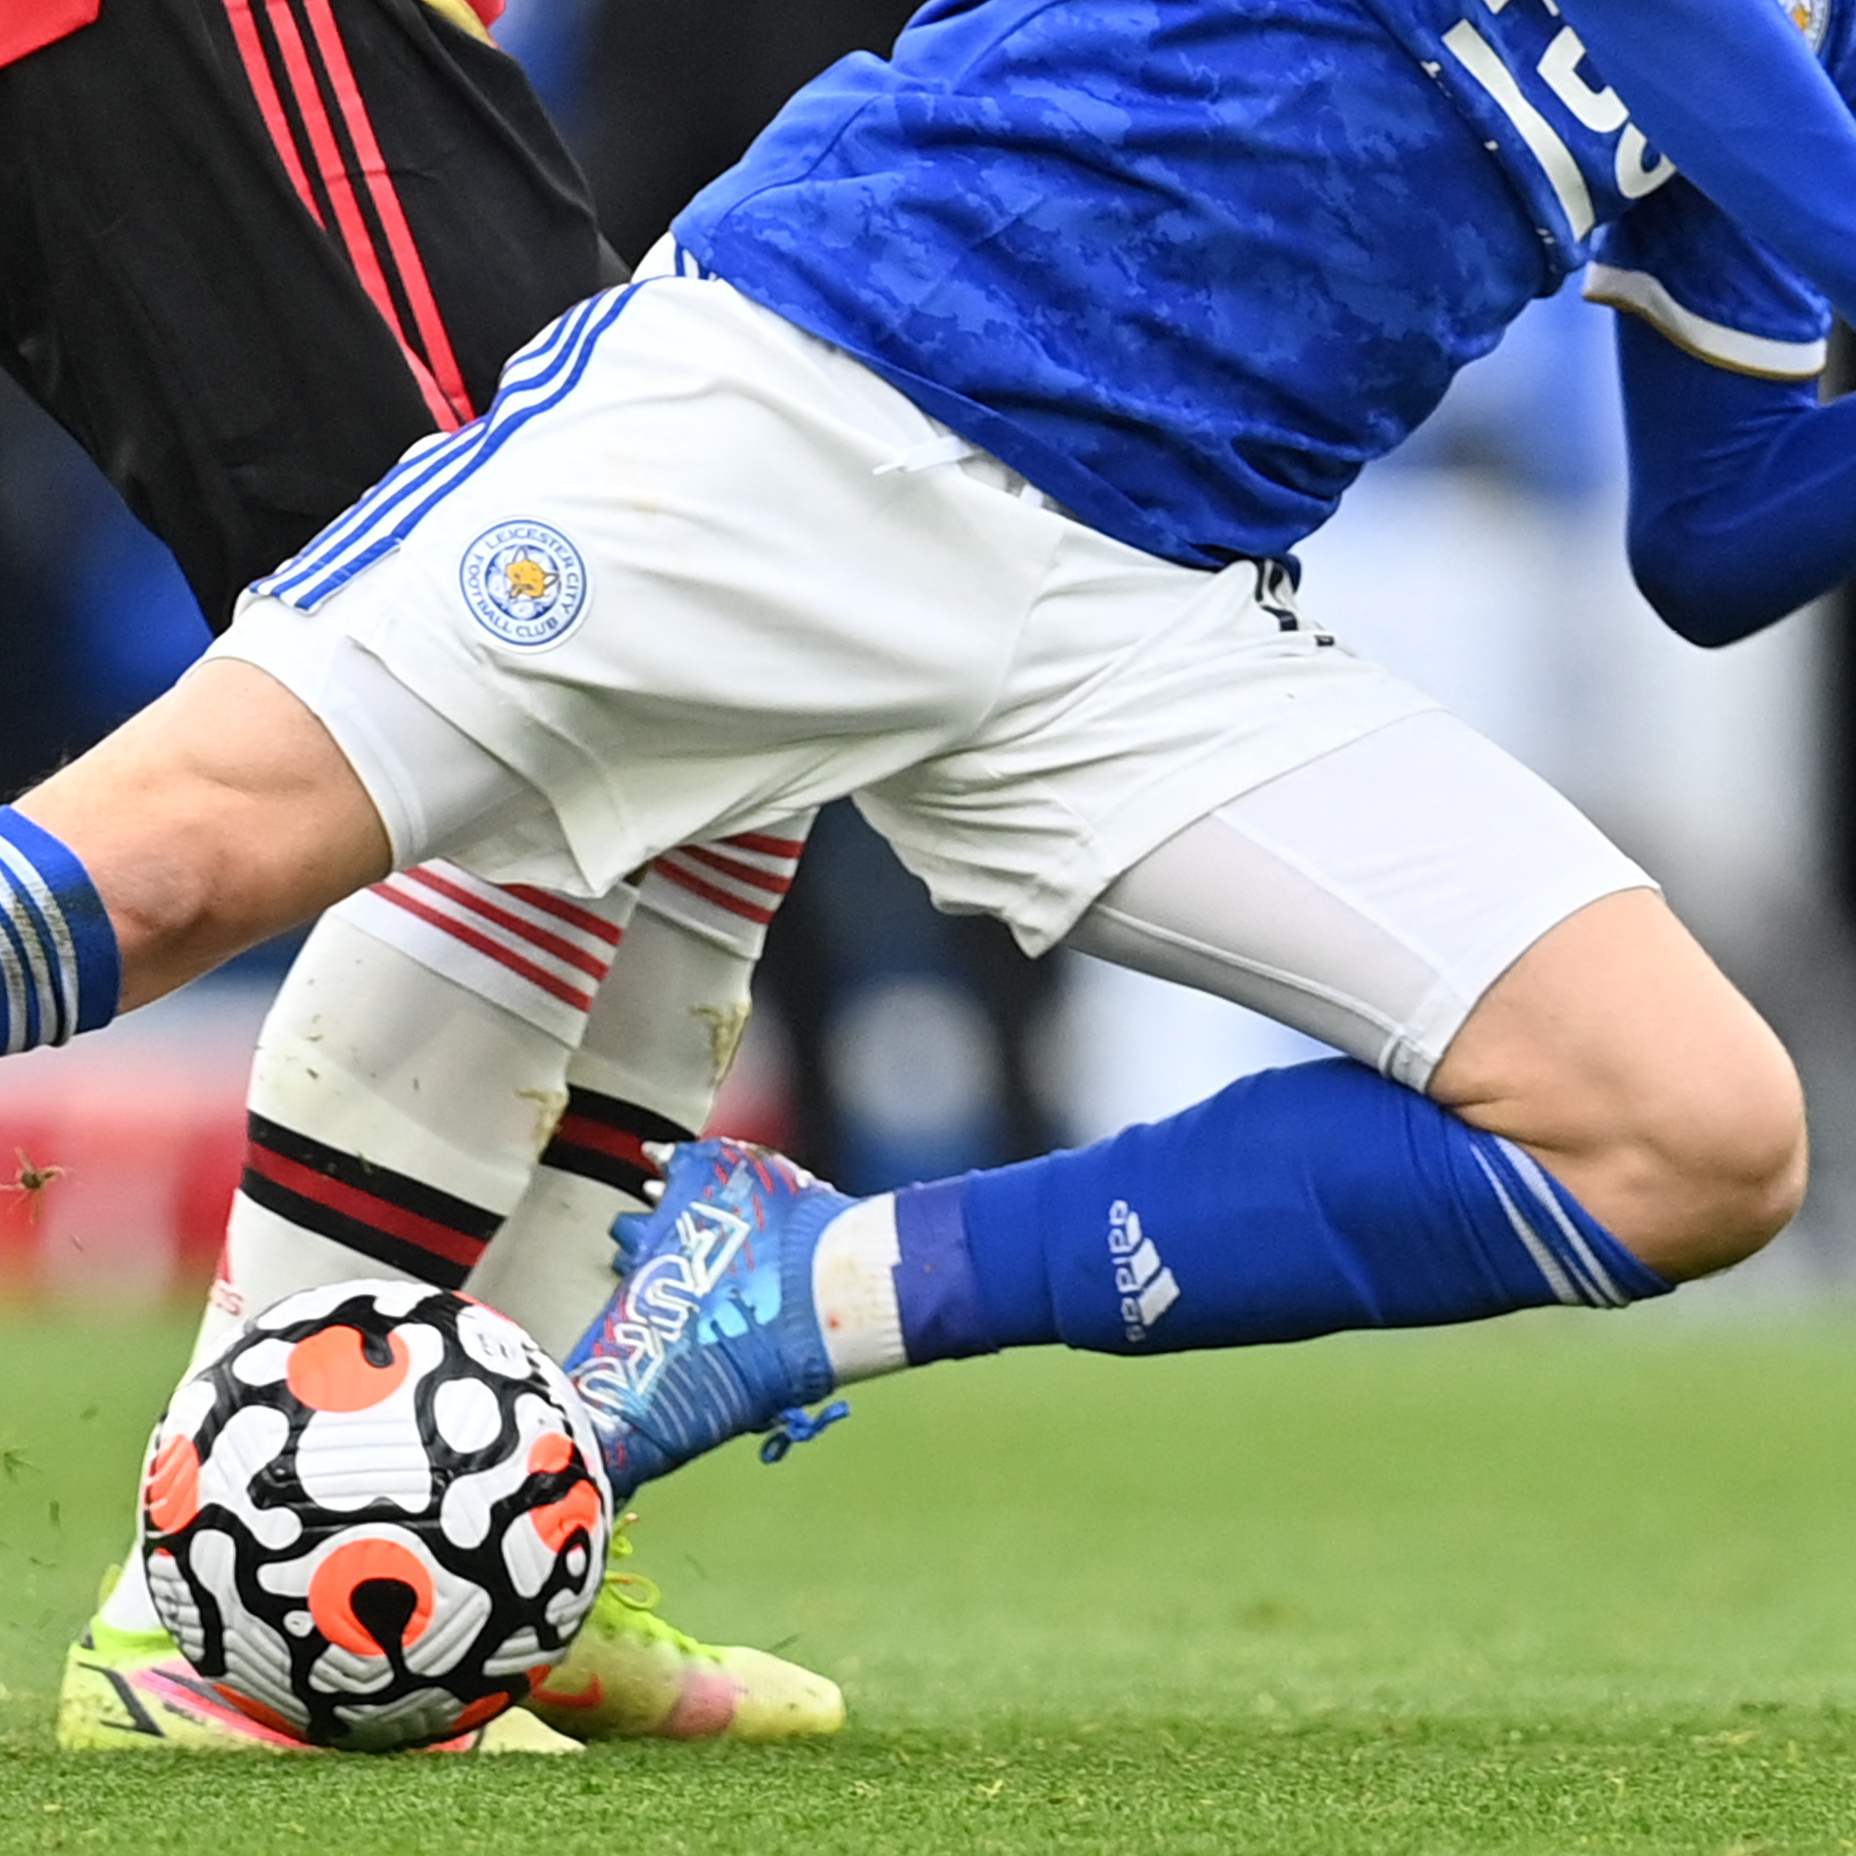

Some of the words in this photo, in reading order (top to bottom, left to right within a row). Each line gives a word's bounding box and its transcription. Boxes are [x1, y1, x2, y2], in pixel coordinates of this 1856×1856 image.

[467, 553, 513, 635] FOOTBALL
[515, 616, 560, 638] CLUB
[485, 527, 575, 570] LEICESTER
[561, 572, 580, 616] CITY
[1107, 1199, 1146, 1343] adidas
